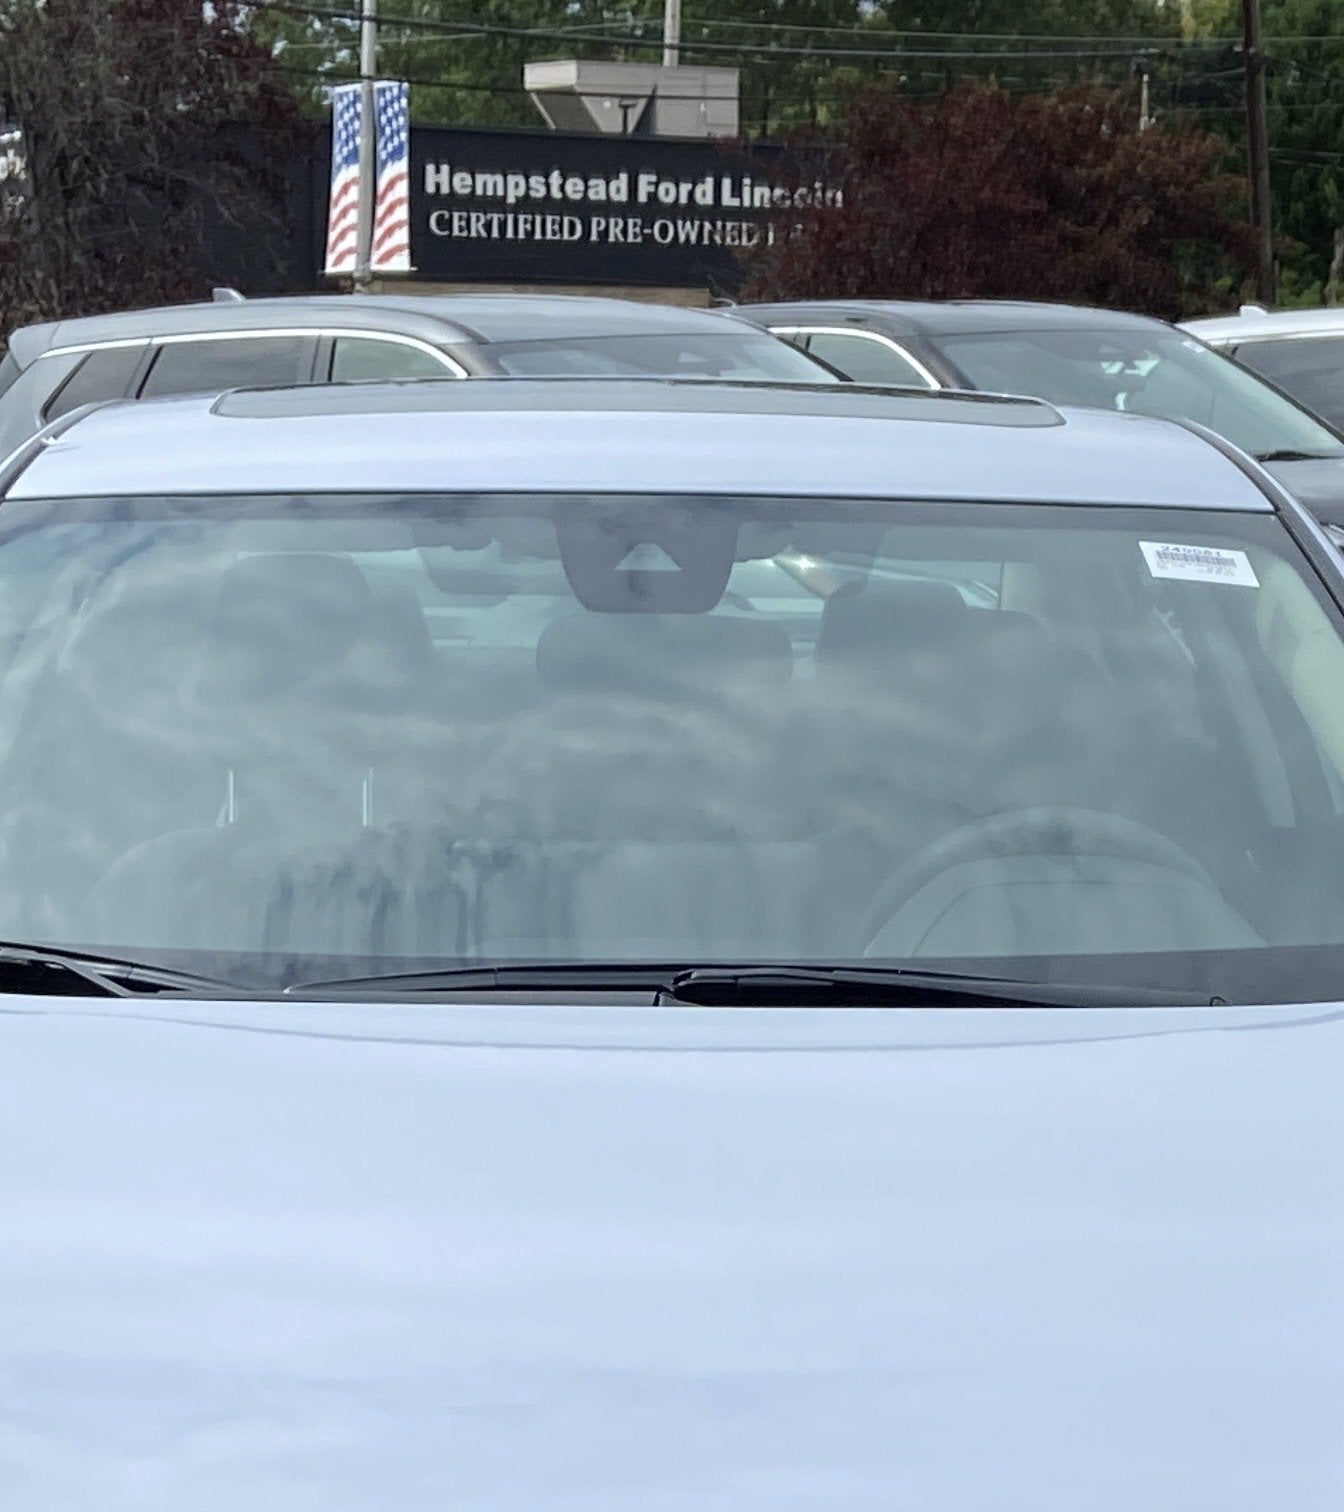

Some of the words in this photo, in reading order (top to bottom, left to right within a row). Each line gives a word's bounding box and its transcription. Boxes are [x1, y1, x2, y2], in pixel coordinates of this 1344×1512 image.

[424, 162, 629, 205] Hempstead
[637, 172, 715, 206] Ford
[429, 209, 583, 241] CERTIFIED
[590, 216, 760, 247] PRE-OWNED
